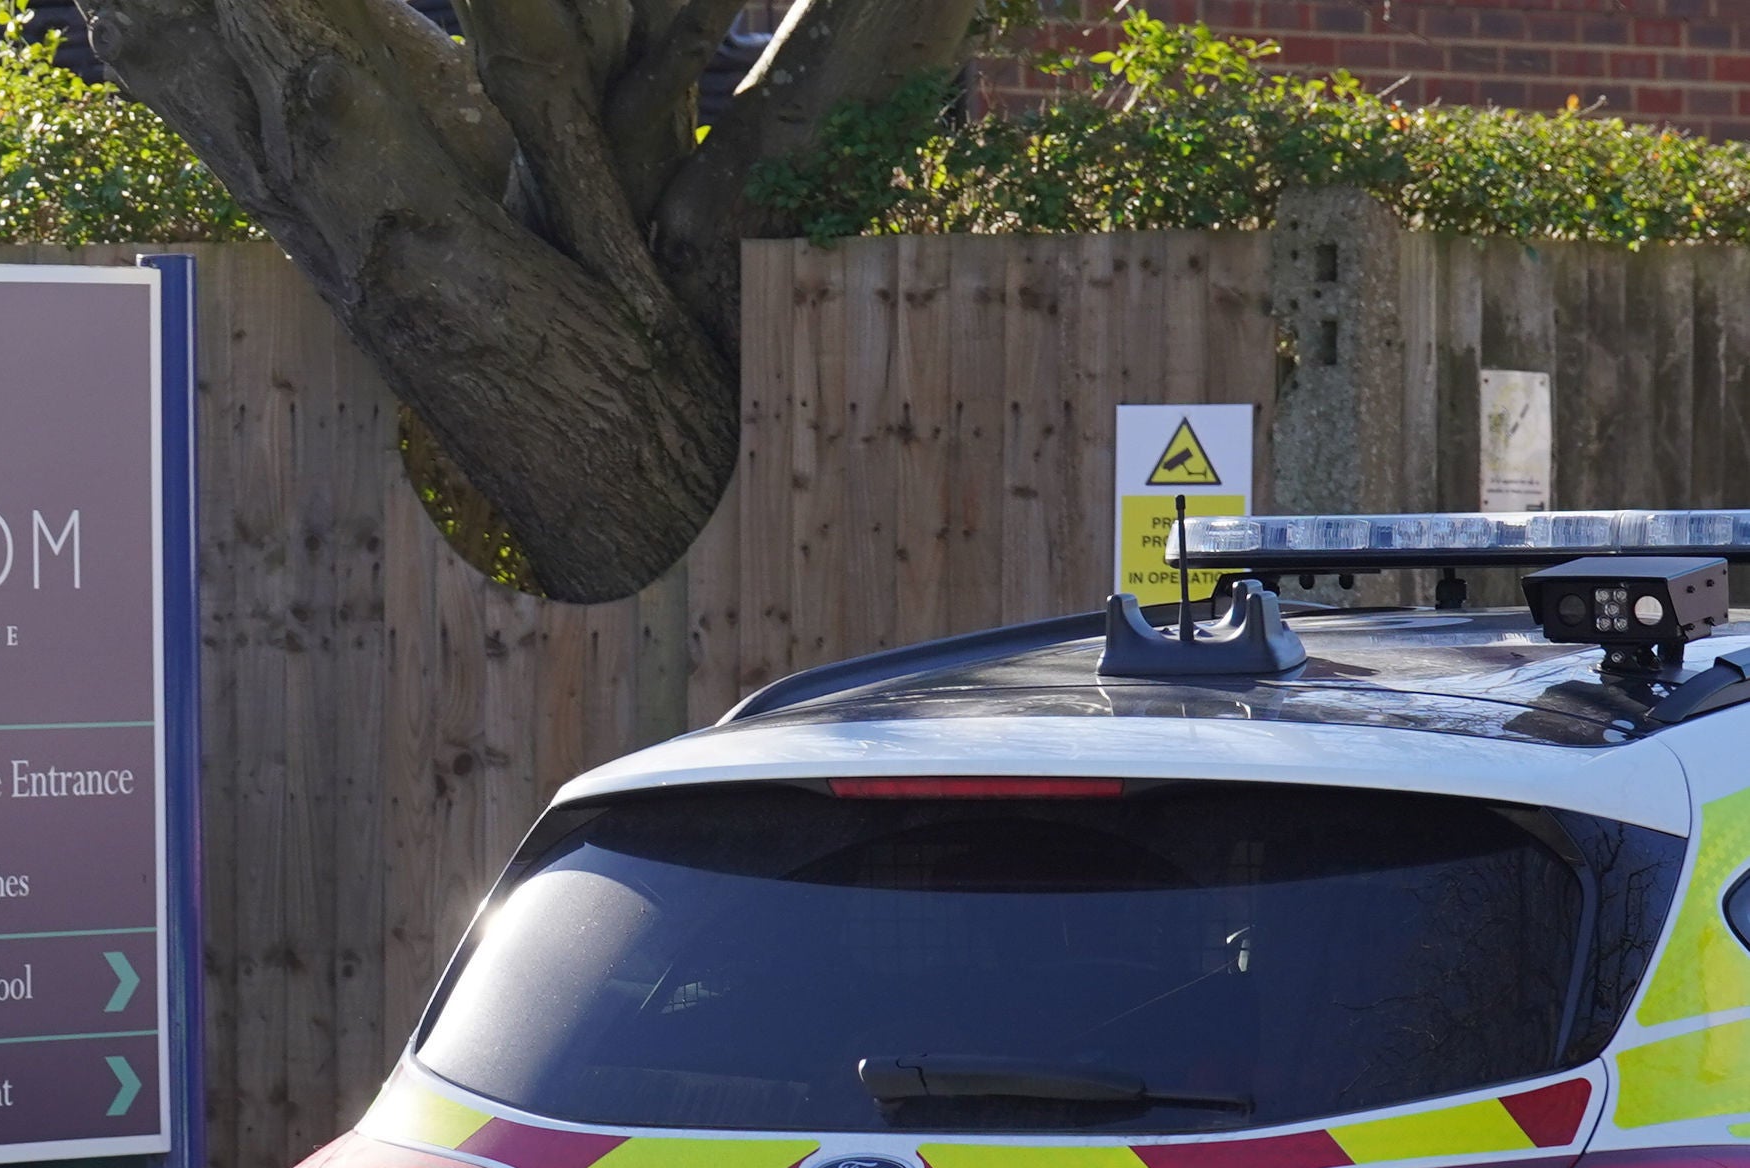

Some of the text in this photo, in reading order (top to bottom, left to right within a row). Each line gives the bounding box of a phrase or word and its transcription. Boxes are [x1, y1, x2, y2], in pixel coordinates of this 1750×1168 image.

[1129, 570, 1222, 585] IN OPEATI
[10, 758, 134, 799] Entrance
